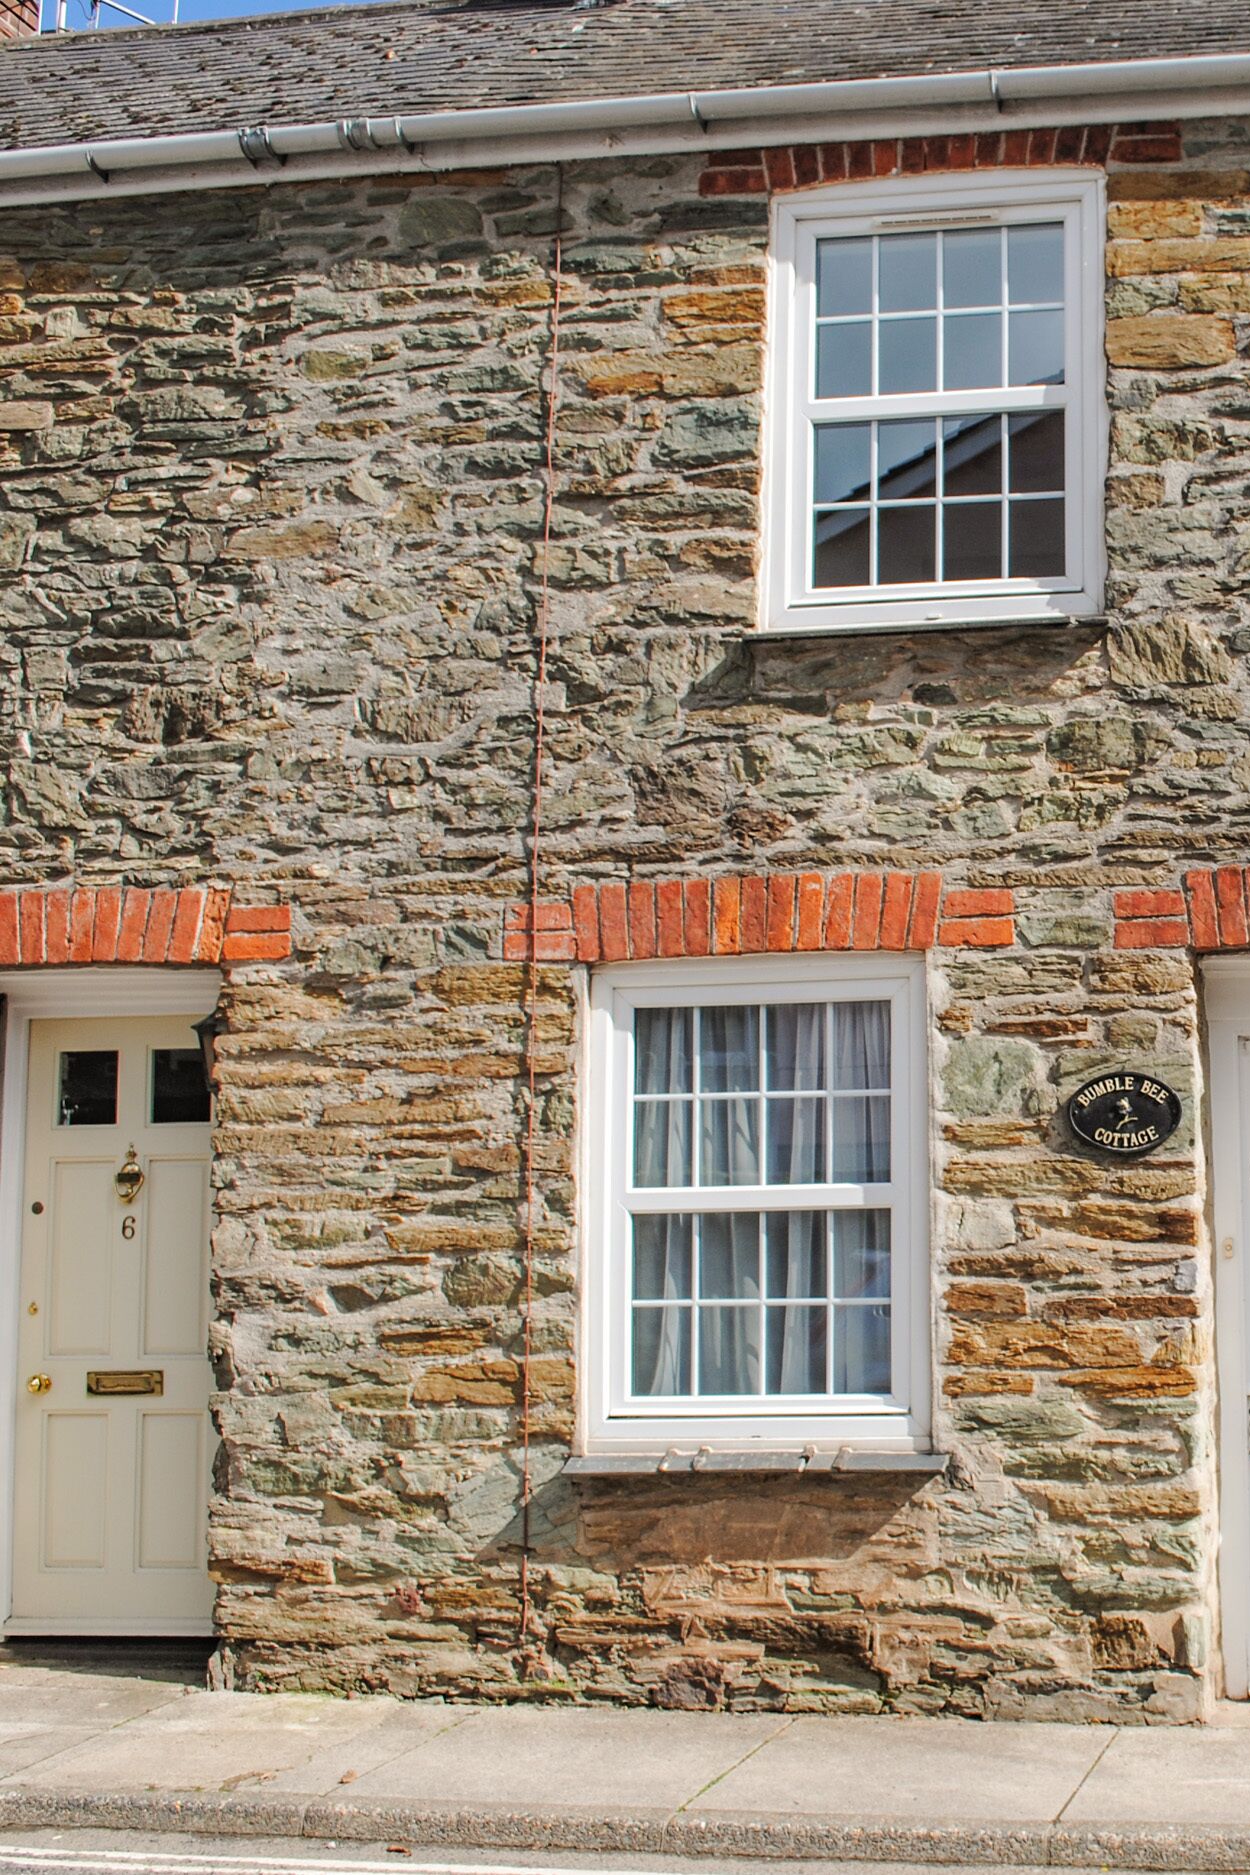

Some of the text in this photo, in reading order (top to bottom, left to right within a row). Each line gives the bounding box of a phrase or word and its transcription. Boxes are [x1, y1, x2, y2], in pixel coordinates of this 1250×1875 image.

[1077, 1076, 1169, 1107] BUMBLE BEE
[1094, 1126, 1159, 1147] COTTAGE
[122, 1216, 136, 1240] 6
